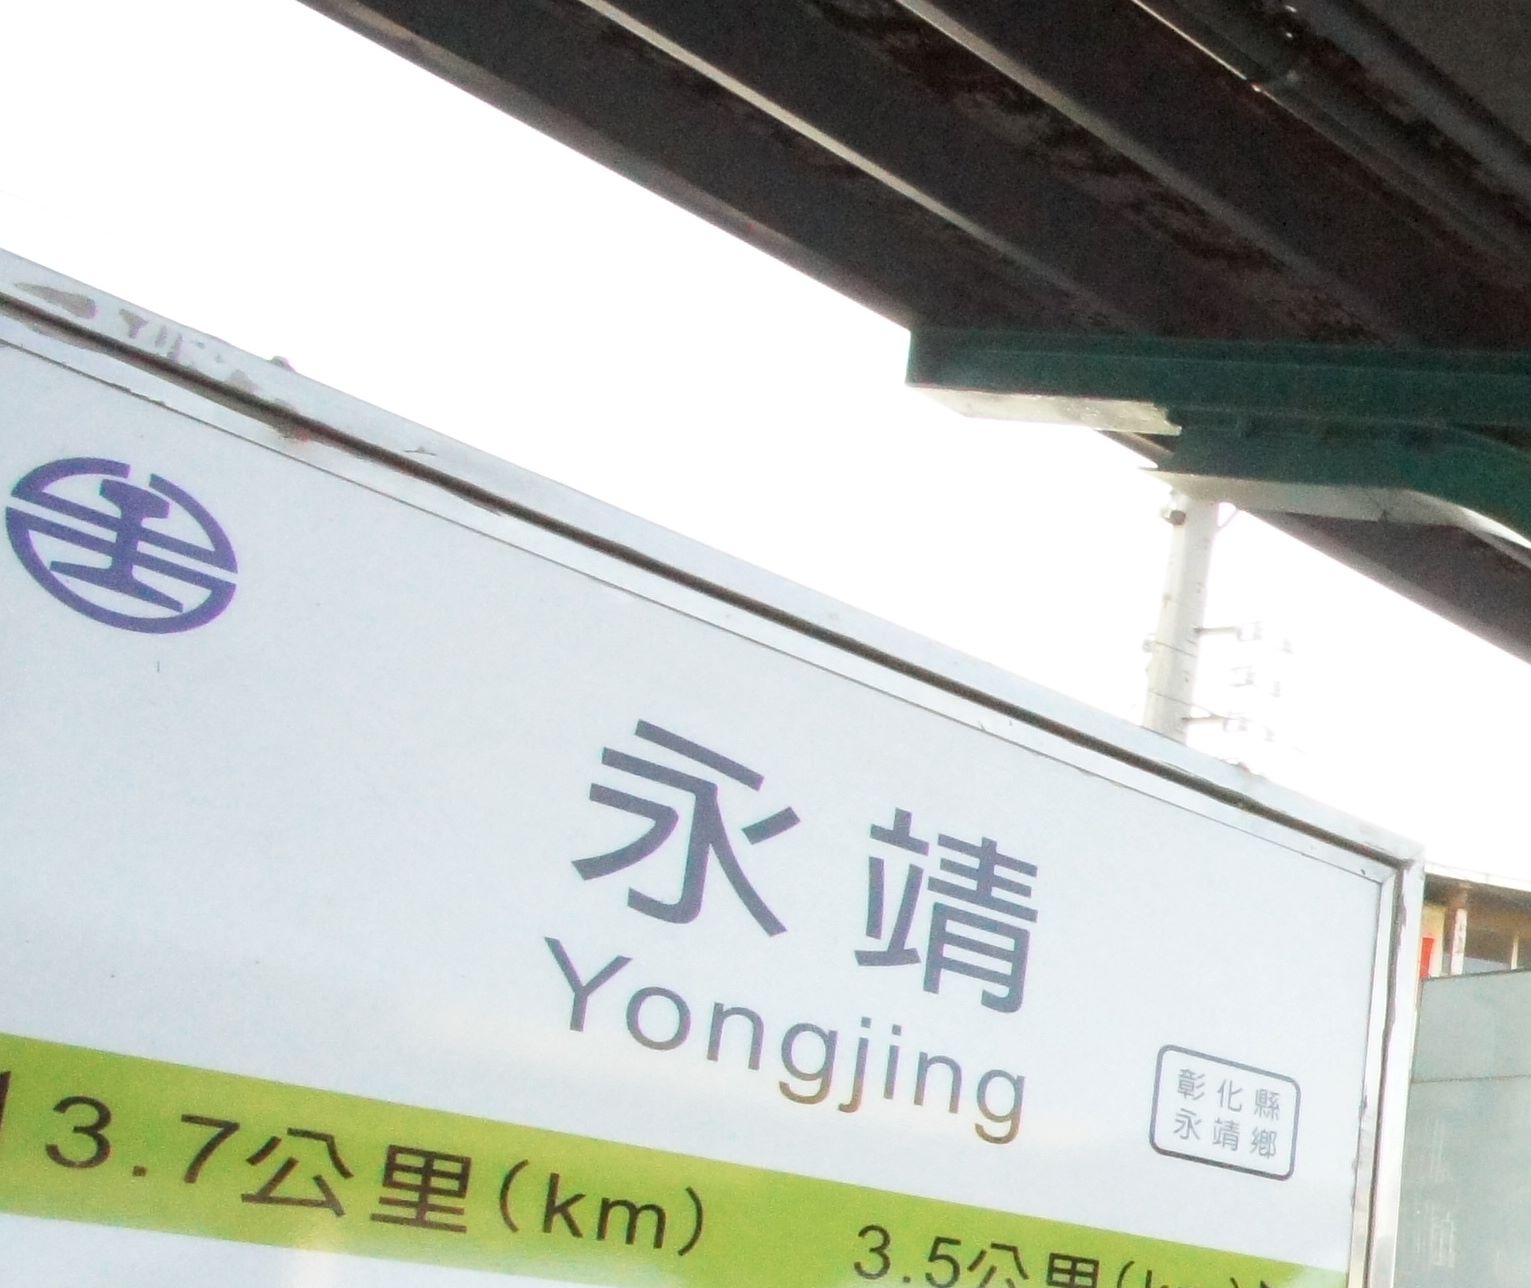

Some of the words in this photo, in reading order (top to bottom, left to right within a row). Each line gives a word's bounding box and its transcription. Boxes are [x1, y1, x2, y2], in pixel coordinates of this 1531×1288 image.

[571, 719, 1038, 1014] 永靖
[544, 936, 1026, 1145] Yongjing
[1177, 1069, 1280, 1121] 彰化縣
[1174, 1107, 1278, 1159] 永靖鄉
